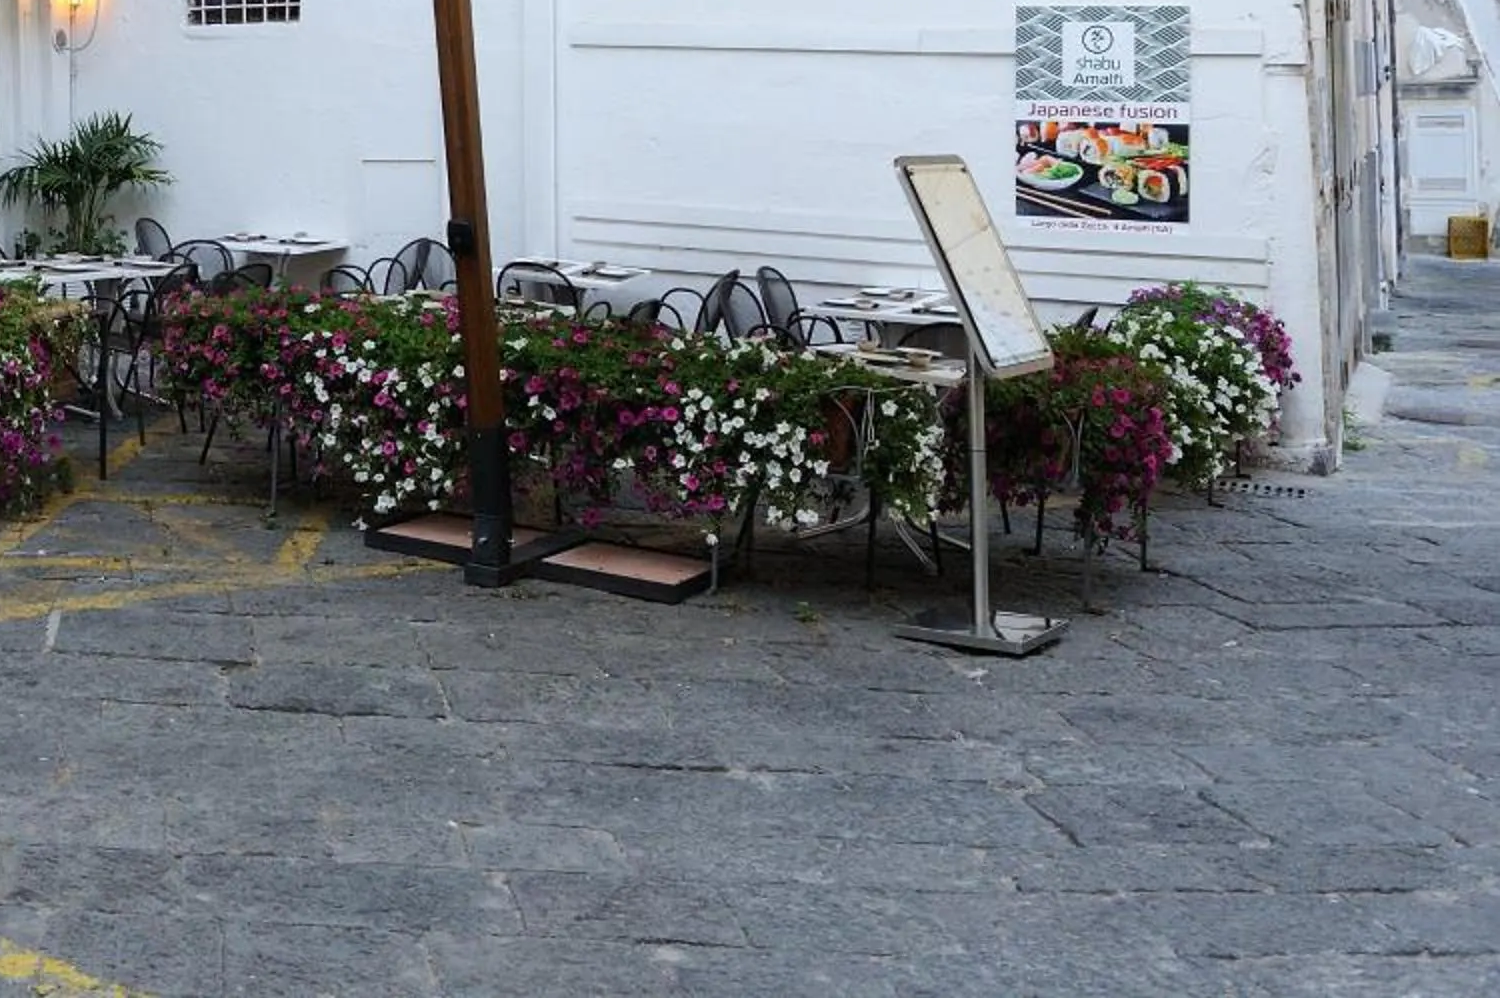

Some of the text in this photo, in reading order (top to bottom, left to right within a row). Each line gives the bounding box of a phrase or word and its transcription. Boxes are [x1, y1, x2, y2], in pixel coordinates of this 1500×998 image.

[1075, 55, 1121, 71] shabu
[1073, 72, 1123, 85] Amalfi
[1027, 102, 1177, 120] Japanese fusion
